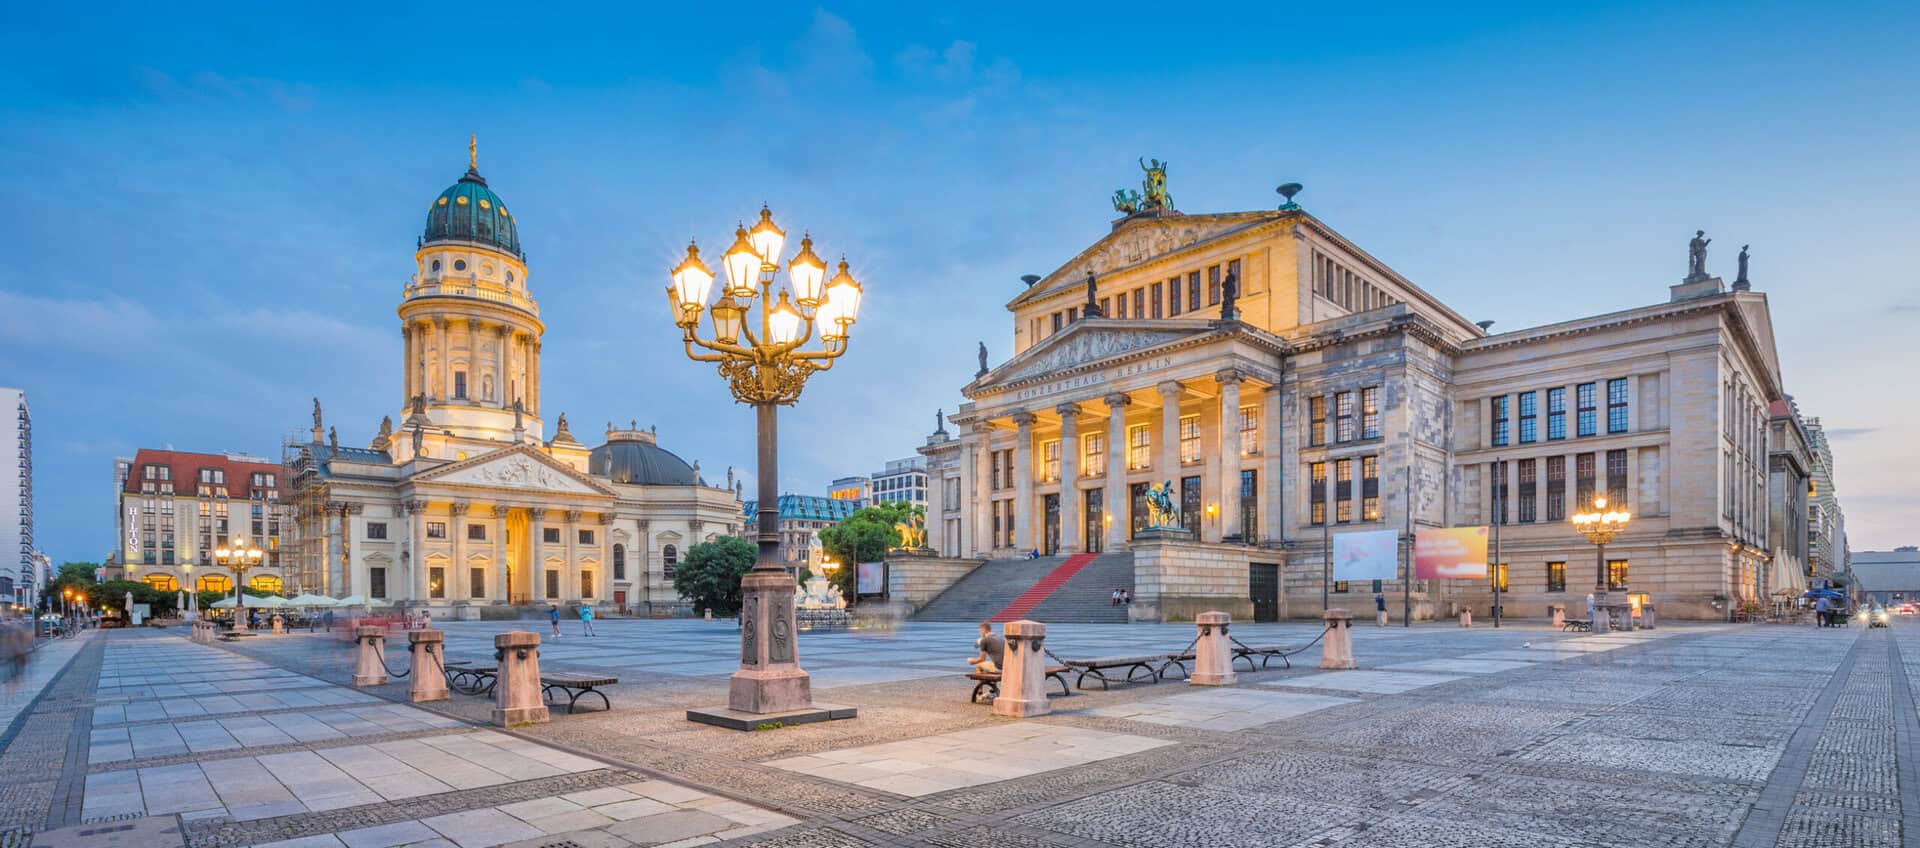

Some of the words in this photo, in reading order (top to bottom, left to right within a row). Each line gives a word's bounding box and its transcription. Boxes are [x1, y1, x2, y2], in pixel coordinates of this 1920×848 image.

[1017, 373, 1106, 399] KONZERTHAUS
[1117, 357, 1172, 377] BERLIN
[129, 507, 138, 553] HILTON
